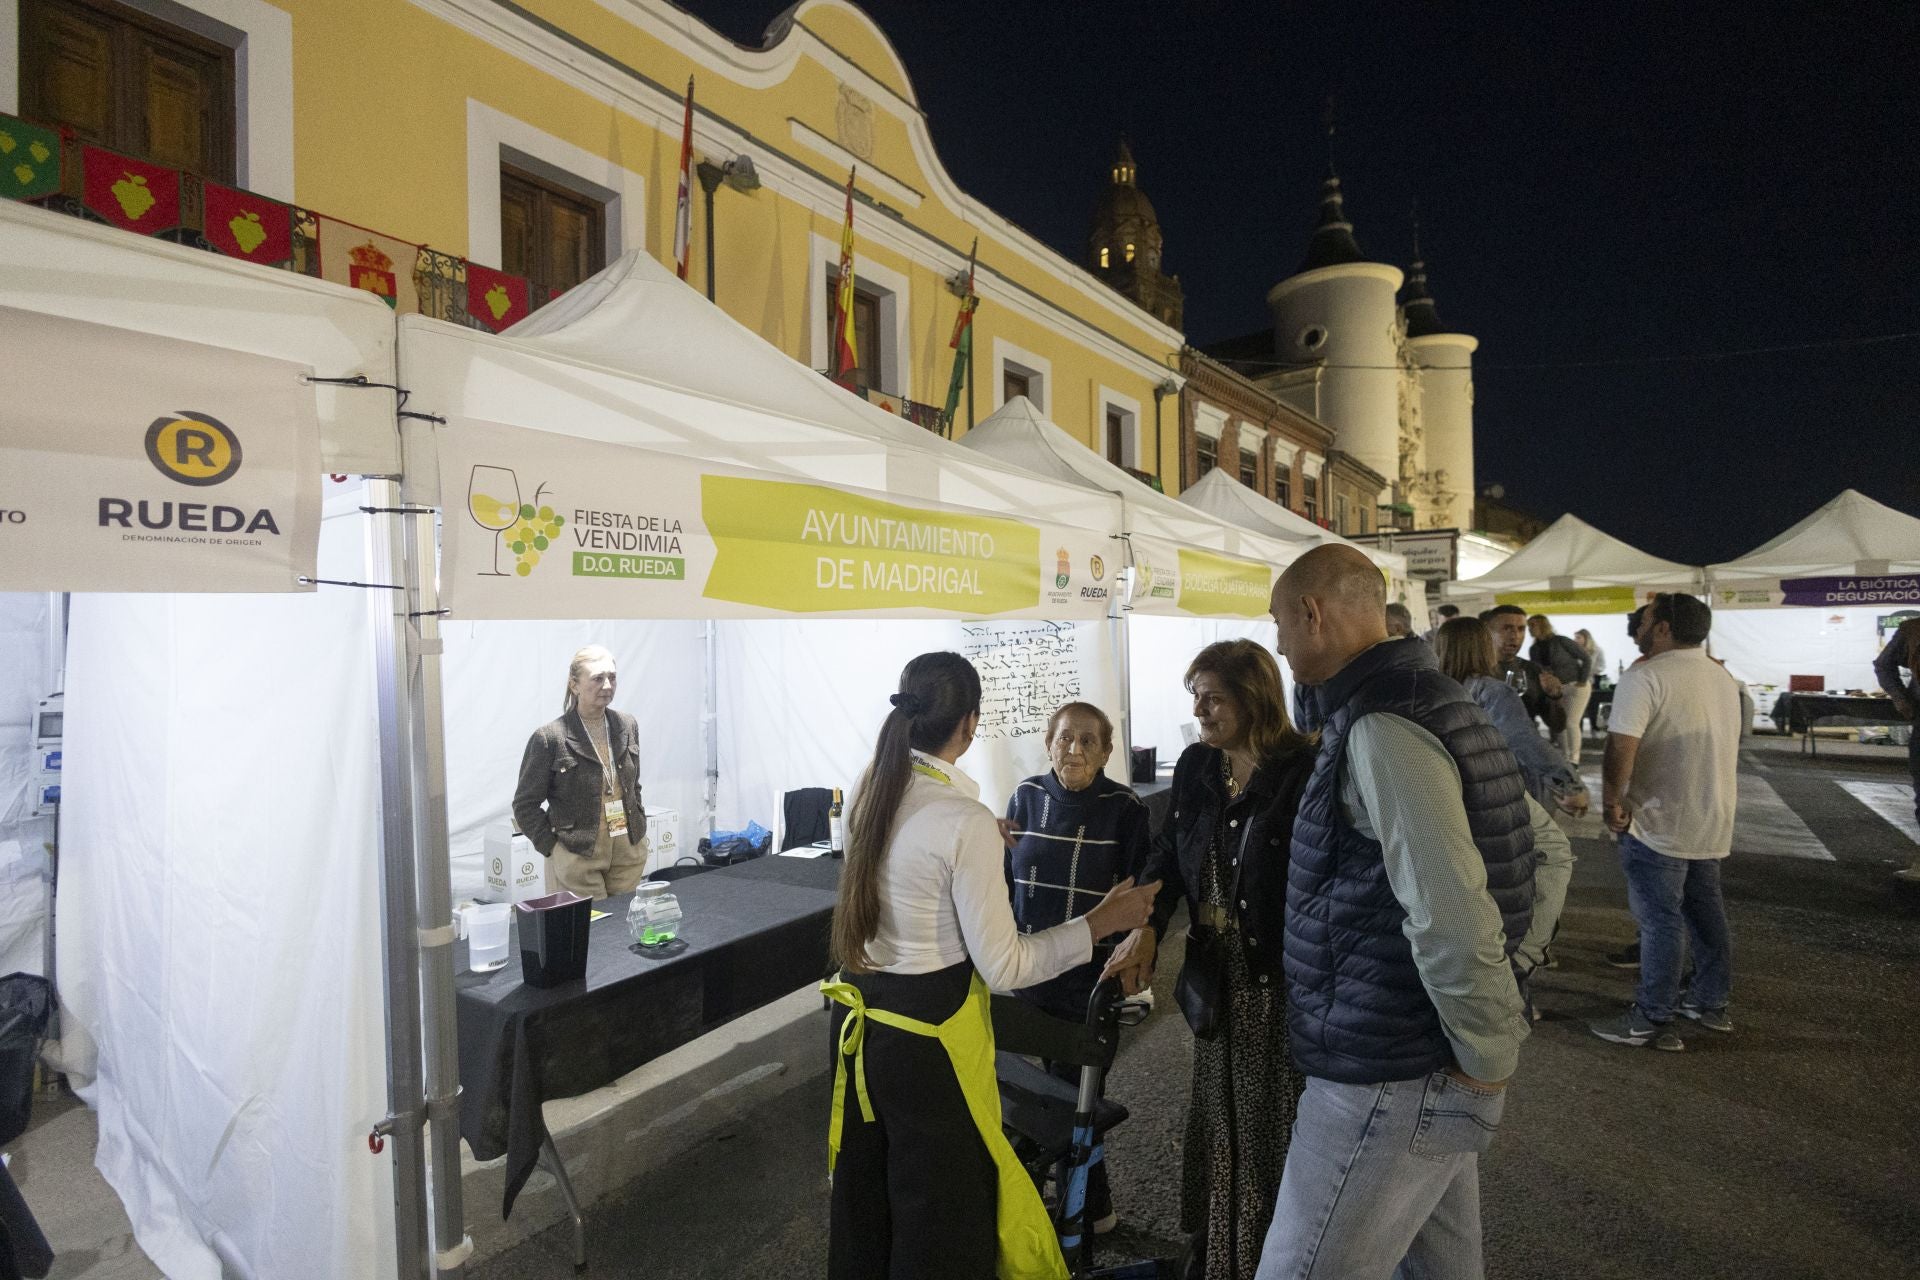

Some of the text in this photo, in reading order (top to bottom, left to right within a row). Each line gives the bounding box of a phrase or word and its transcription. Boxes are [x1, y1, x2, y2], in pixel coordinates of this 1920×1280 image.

[98, 497, 281, 535] RUEDA
[574, 509, 683, 534] FIESTA DE LA
[122, 534, 262, 546] DENOMINACIÓN DE ORIGEN
[573, 527, 683, 555] VENDIMIA
[800, 508, 995, 559] AYUNTAMIENTO
[582, 555, 677, 576] D.O. RUEDA
[816, 556, 984, 595] DE MADRIGAL
[1080, 586, 1108, 598] RUEDA
[1838, 578, 1919, 591] LA BIÓTICA
[487, 875, 507, 887] RUEDA
[515, 874, 539, 885] RUEDA
